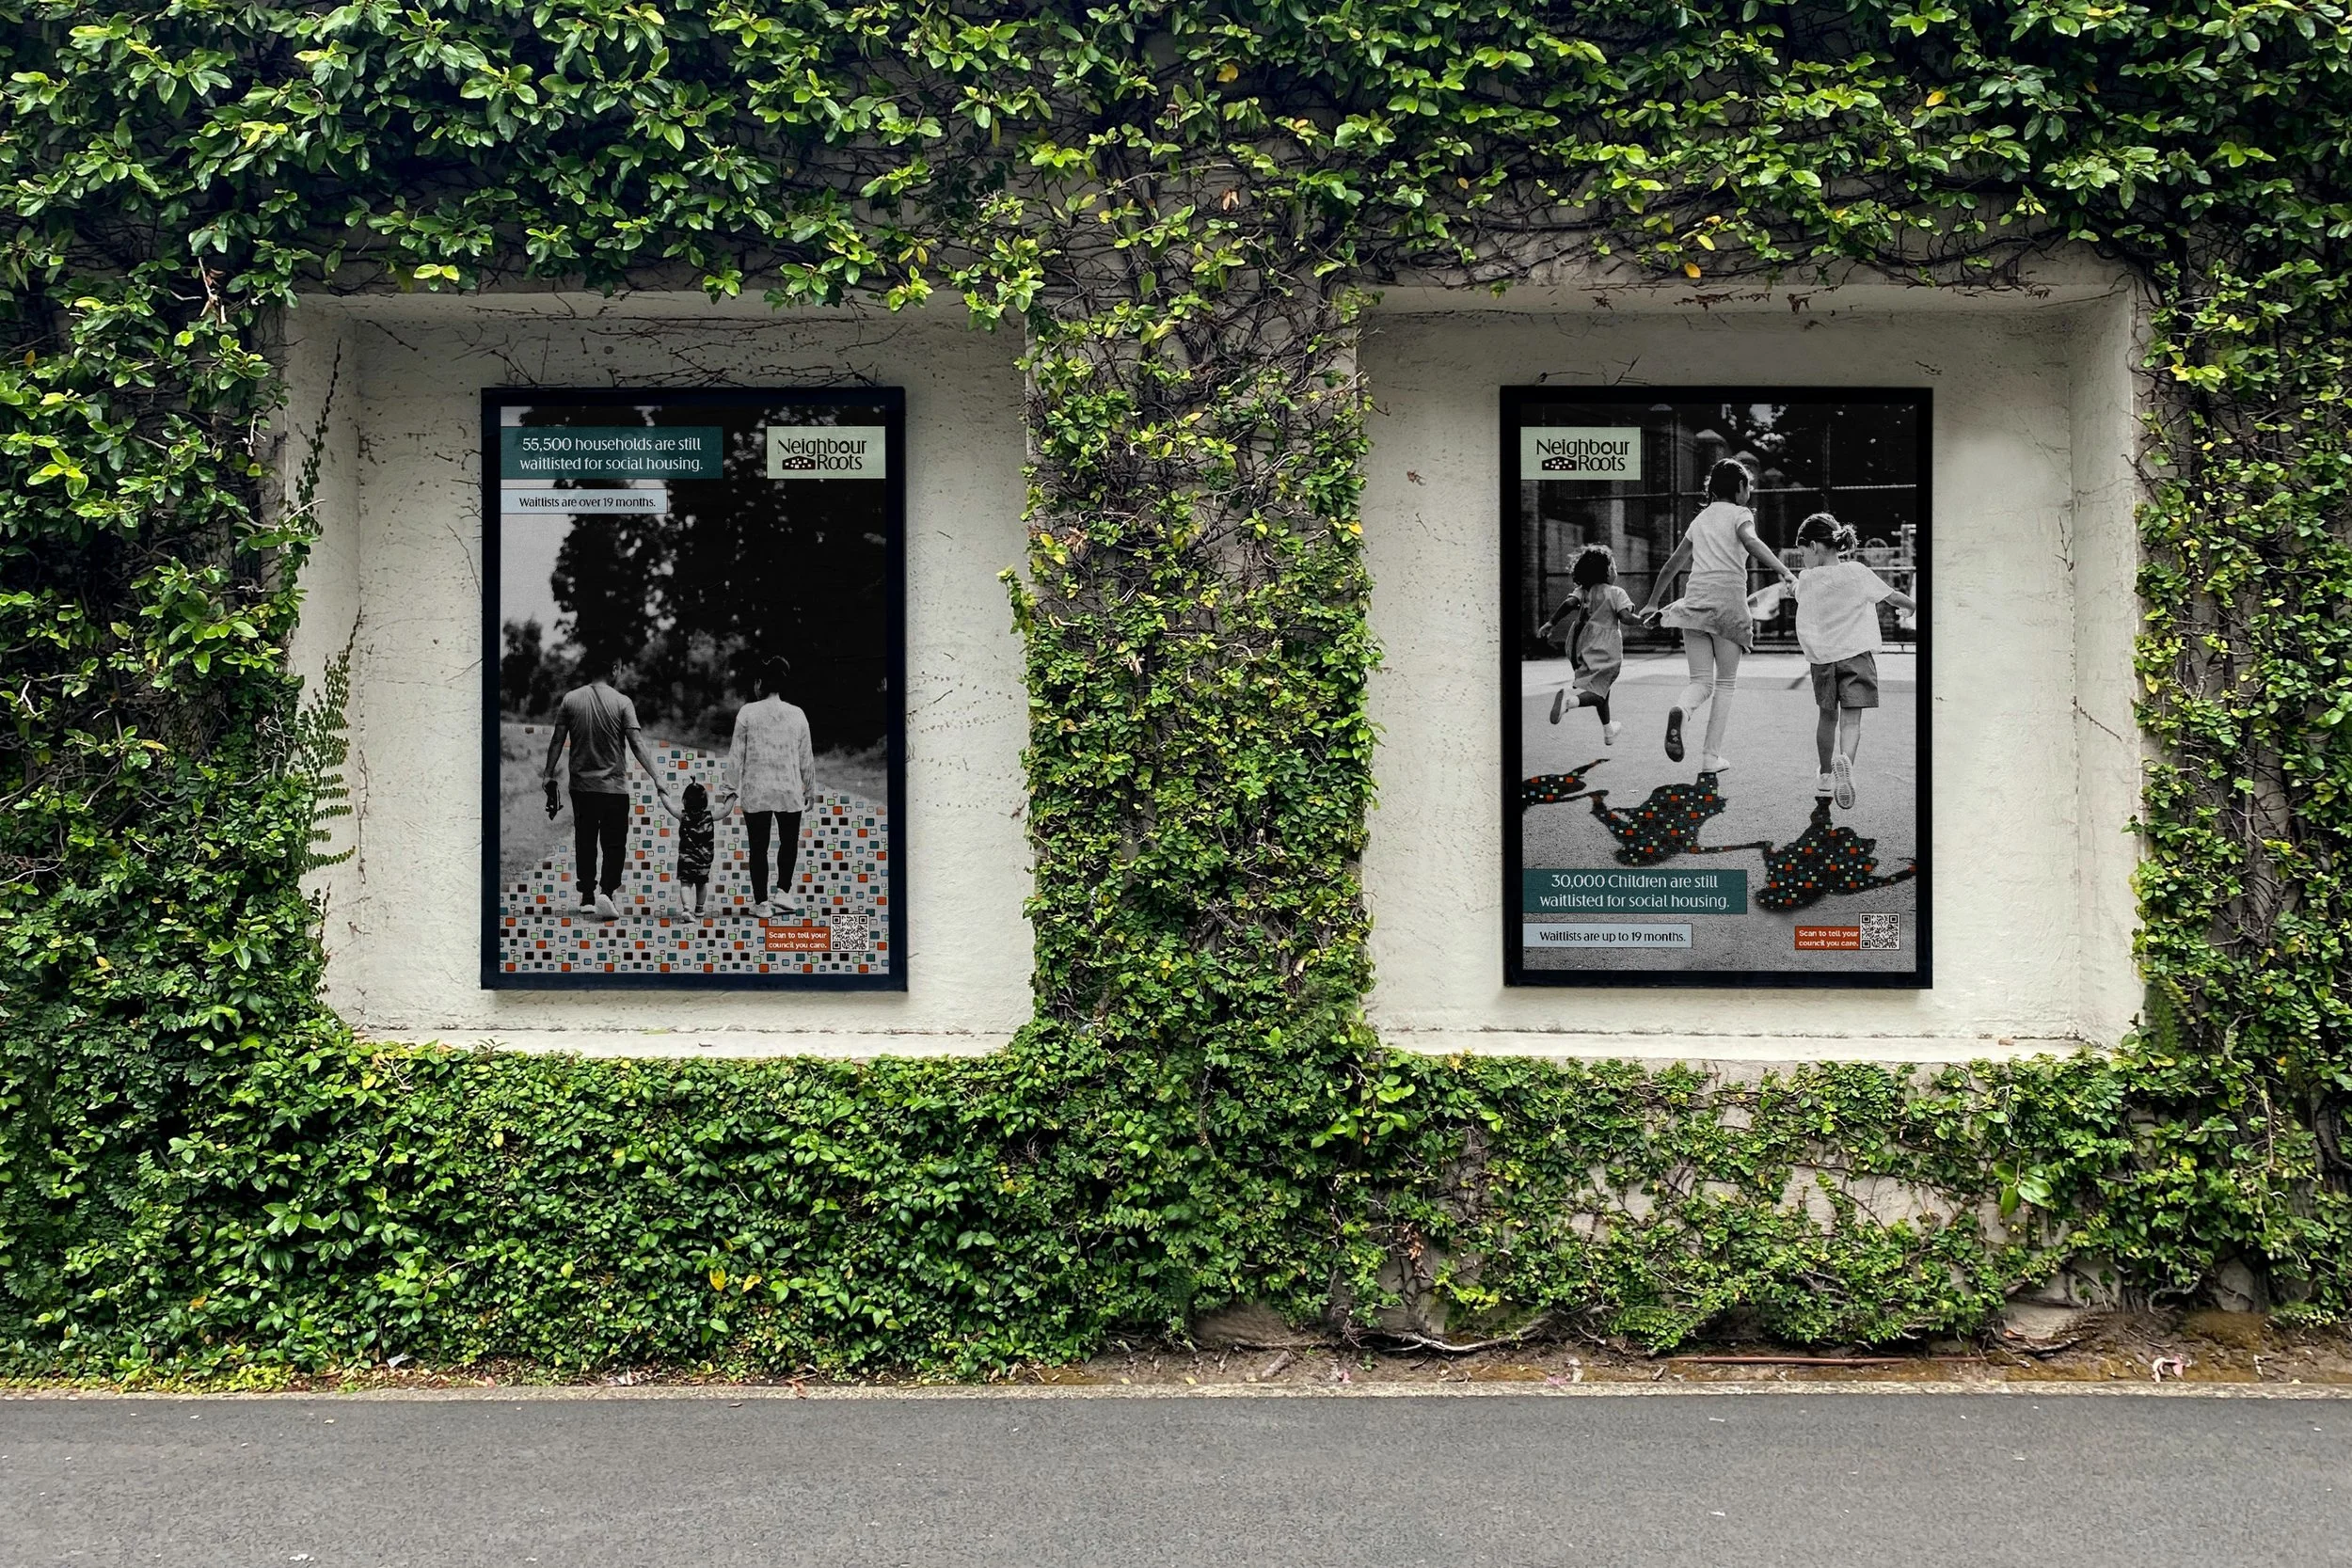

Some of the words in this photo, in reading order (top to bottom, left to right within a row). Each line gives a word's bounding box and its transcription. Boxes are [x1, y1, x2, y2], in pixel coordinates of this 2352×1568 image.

[522, 437, 572, 452] 55,500
[575, 437, 652, 451] households
[655, 439, 676, 451] are
[677, 437, 702, 451] still
[777, 438, 867, 457] Neighbour
[1536, 438, 1630, 458] Neighbour
[519, 457, 581, 470] waitlisted
[584, 457, 603, 470] for
[605, 457, 644, 470] social
[646, 457, 704, 472] housing.
[817, 453, 863, 470] Roots
[1578, 454, 1626, 471] Roots
[519, 497, 560, 507] Waitlists
[603, 498, 613, 507] 19
[615, 498, 656, 507] months.
[1550, 874, 1605, 889] 30,000
[1608, 874, 1667, 888] Children
[1670, 877, 1692, 888] are
[1693, 875, 1718, 888] still
[1539, 894, 1603, 908] waitlisted
[1607, 894, 1626, 908] for
[1629, 894, 1668, 908] social
[1671, 894, 1730, 910] housing.
[1539, 931, 1581, 942] Waitlists
[1583, 933, 1599, 942] are
[1601, 933, 1616, 943] up
[1618, 932, 1629, 942] to
[1630, 931, 1642, 941] 19
[1644, 931, 1686, 942] months.
